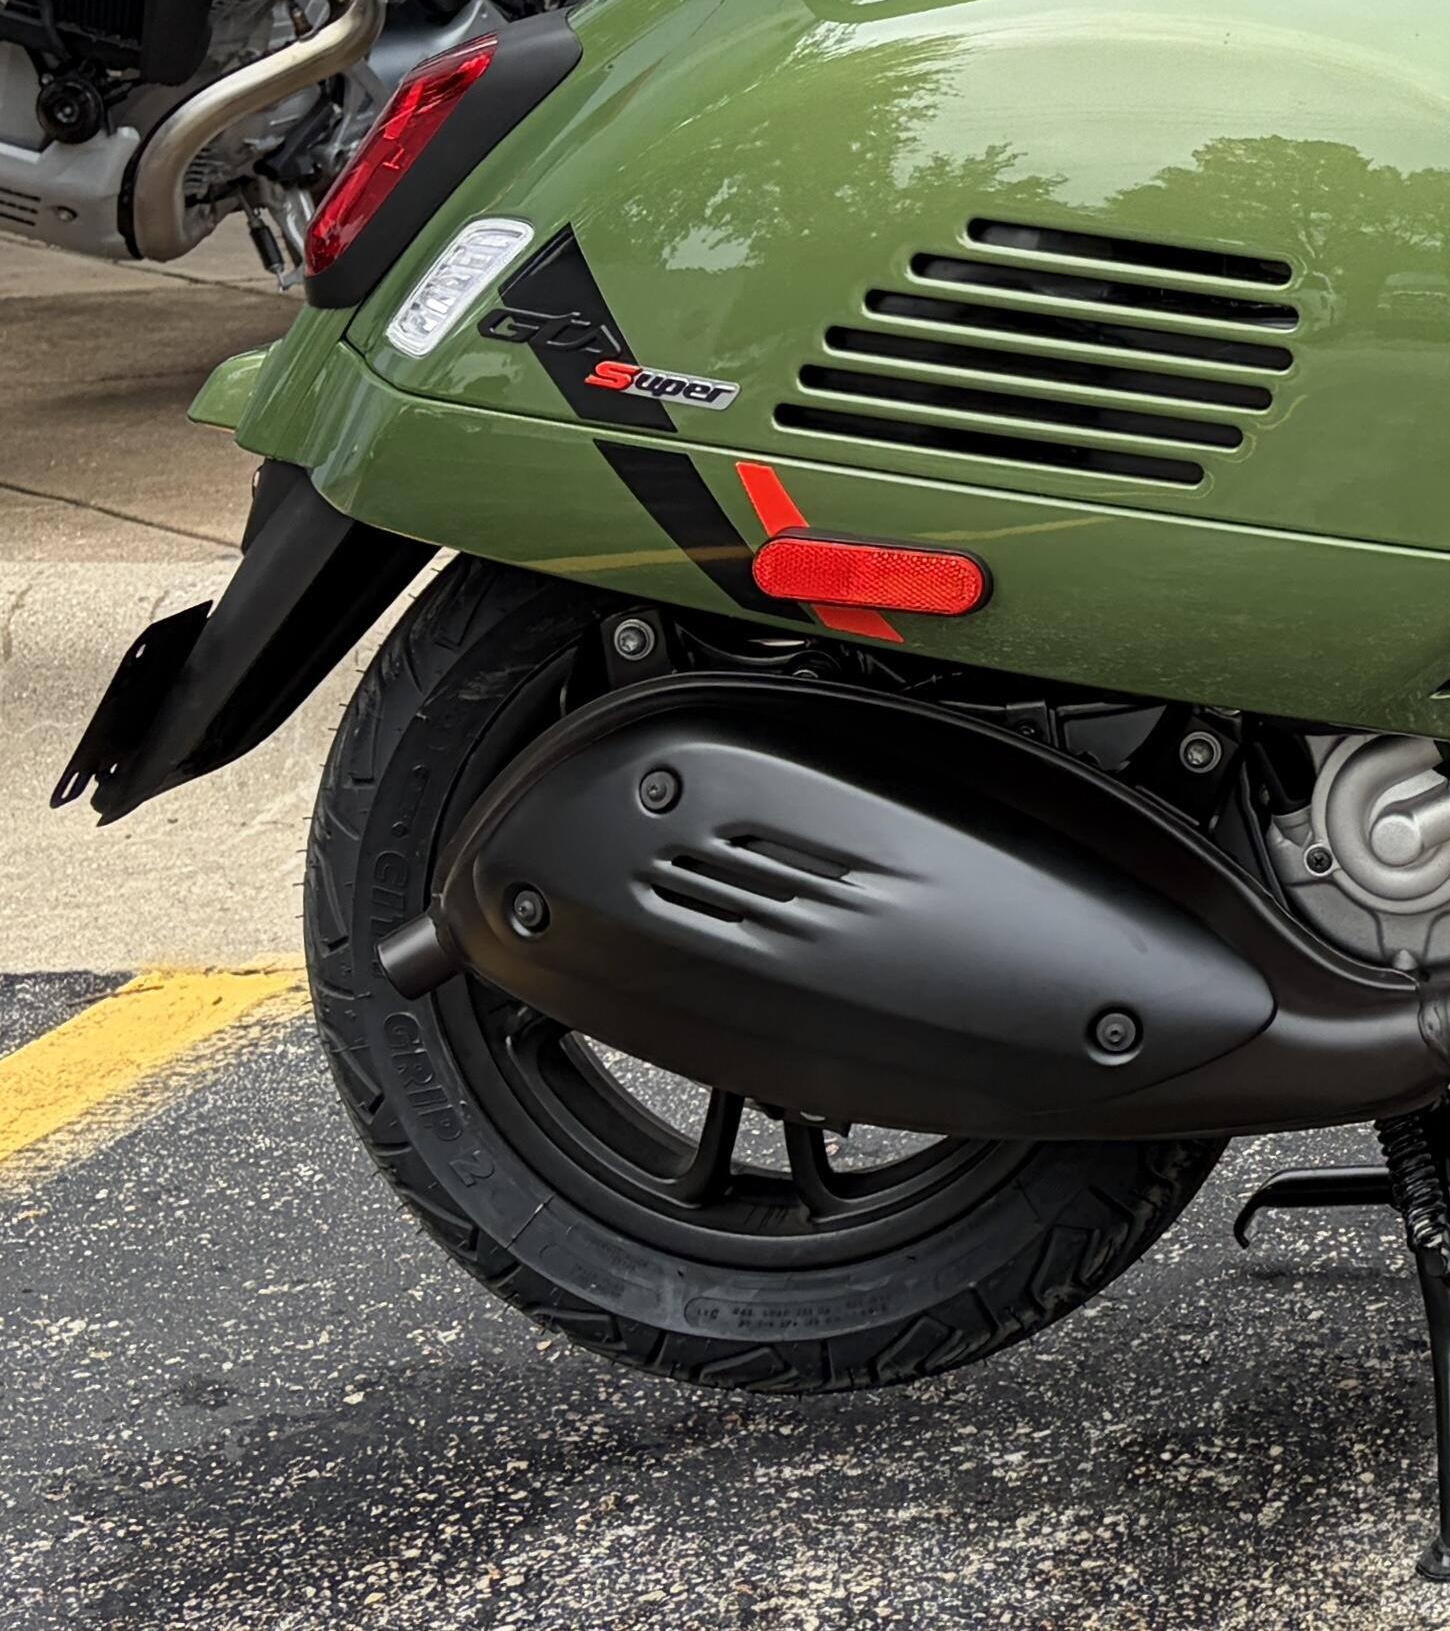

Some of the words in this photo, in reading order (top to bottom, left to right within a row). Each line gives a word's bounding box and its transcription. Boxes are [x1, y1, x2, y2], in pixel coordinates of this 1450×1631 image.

[584, 359, 737, 404] Super
[383, 1011, 462, 1142] GRIP
[448, 1149, 496, 1189] 2
